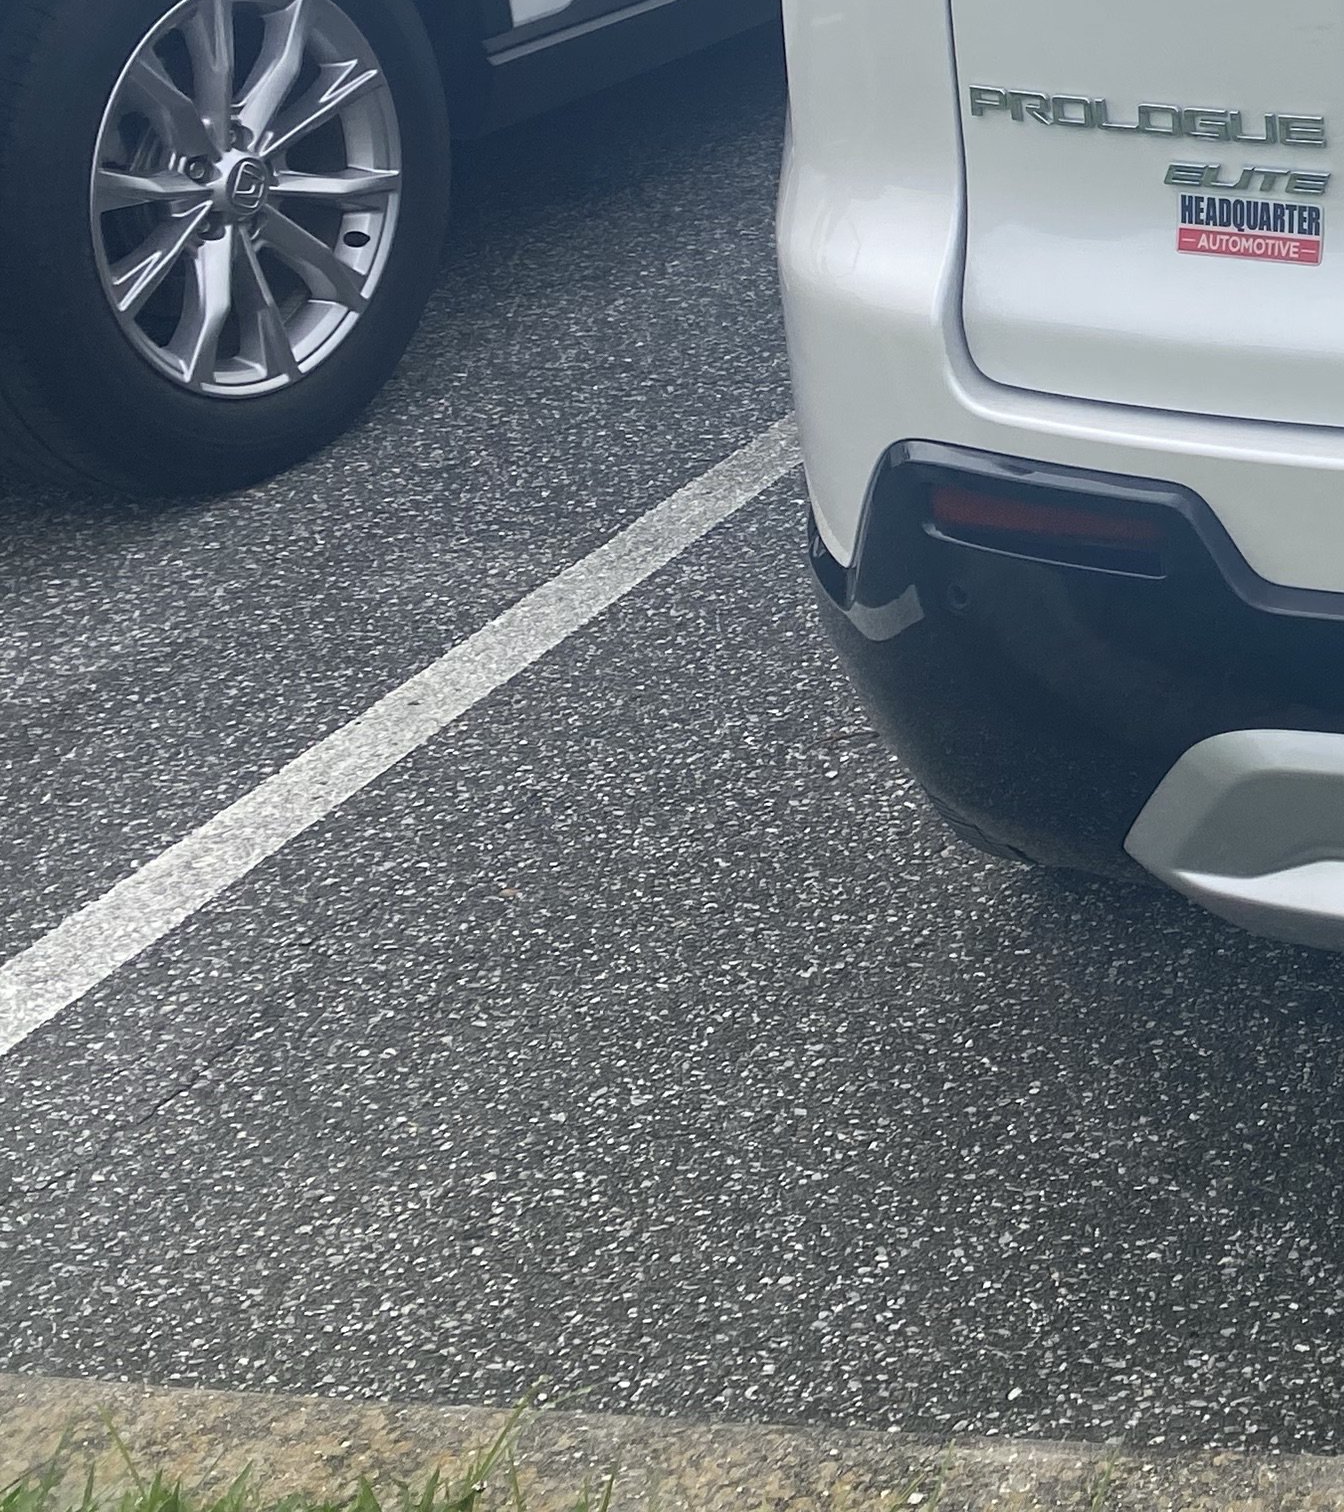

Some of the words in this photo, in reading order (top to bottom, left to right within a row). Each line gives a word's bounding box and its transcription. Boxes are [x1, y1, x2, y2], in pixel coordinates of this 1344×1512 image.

[969, 83, 1327, 148] PROLOGUE
[1164, 161, 1331, 195] ELITE
[1180, 194, 1321, 236] HEADQUARTER
[1197, 233, 1301, 259] AUTOMOTIVE
